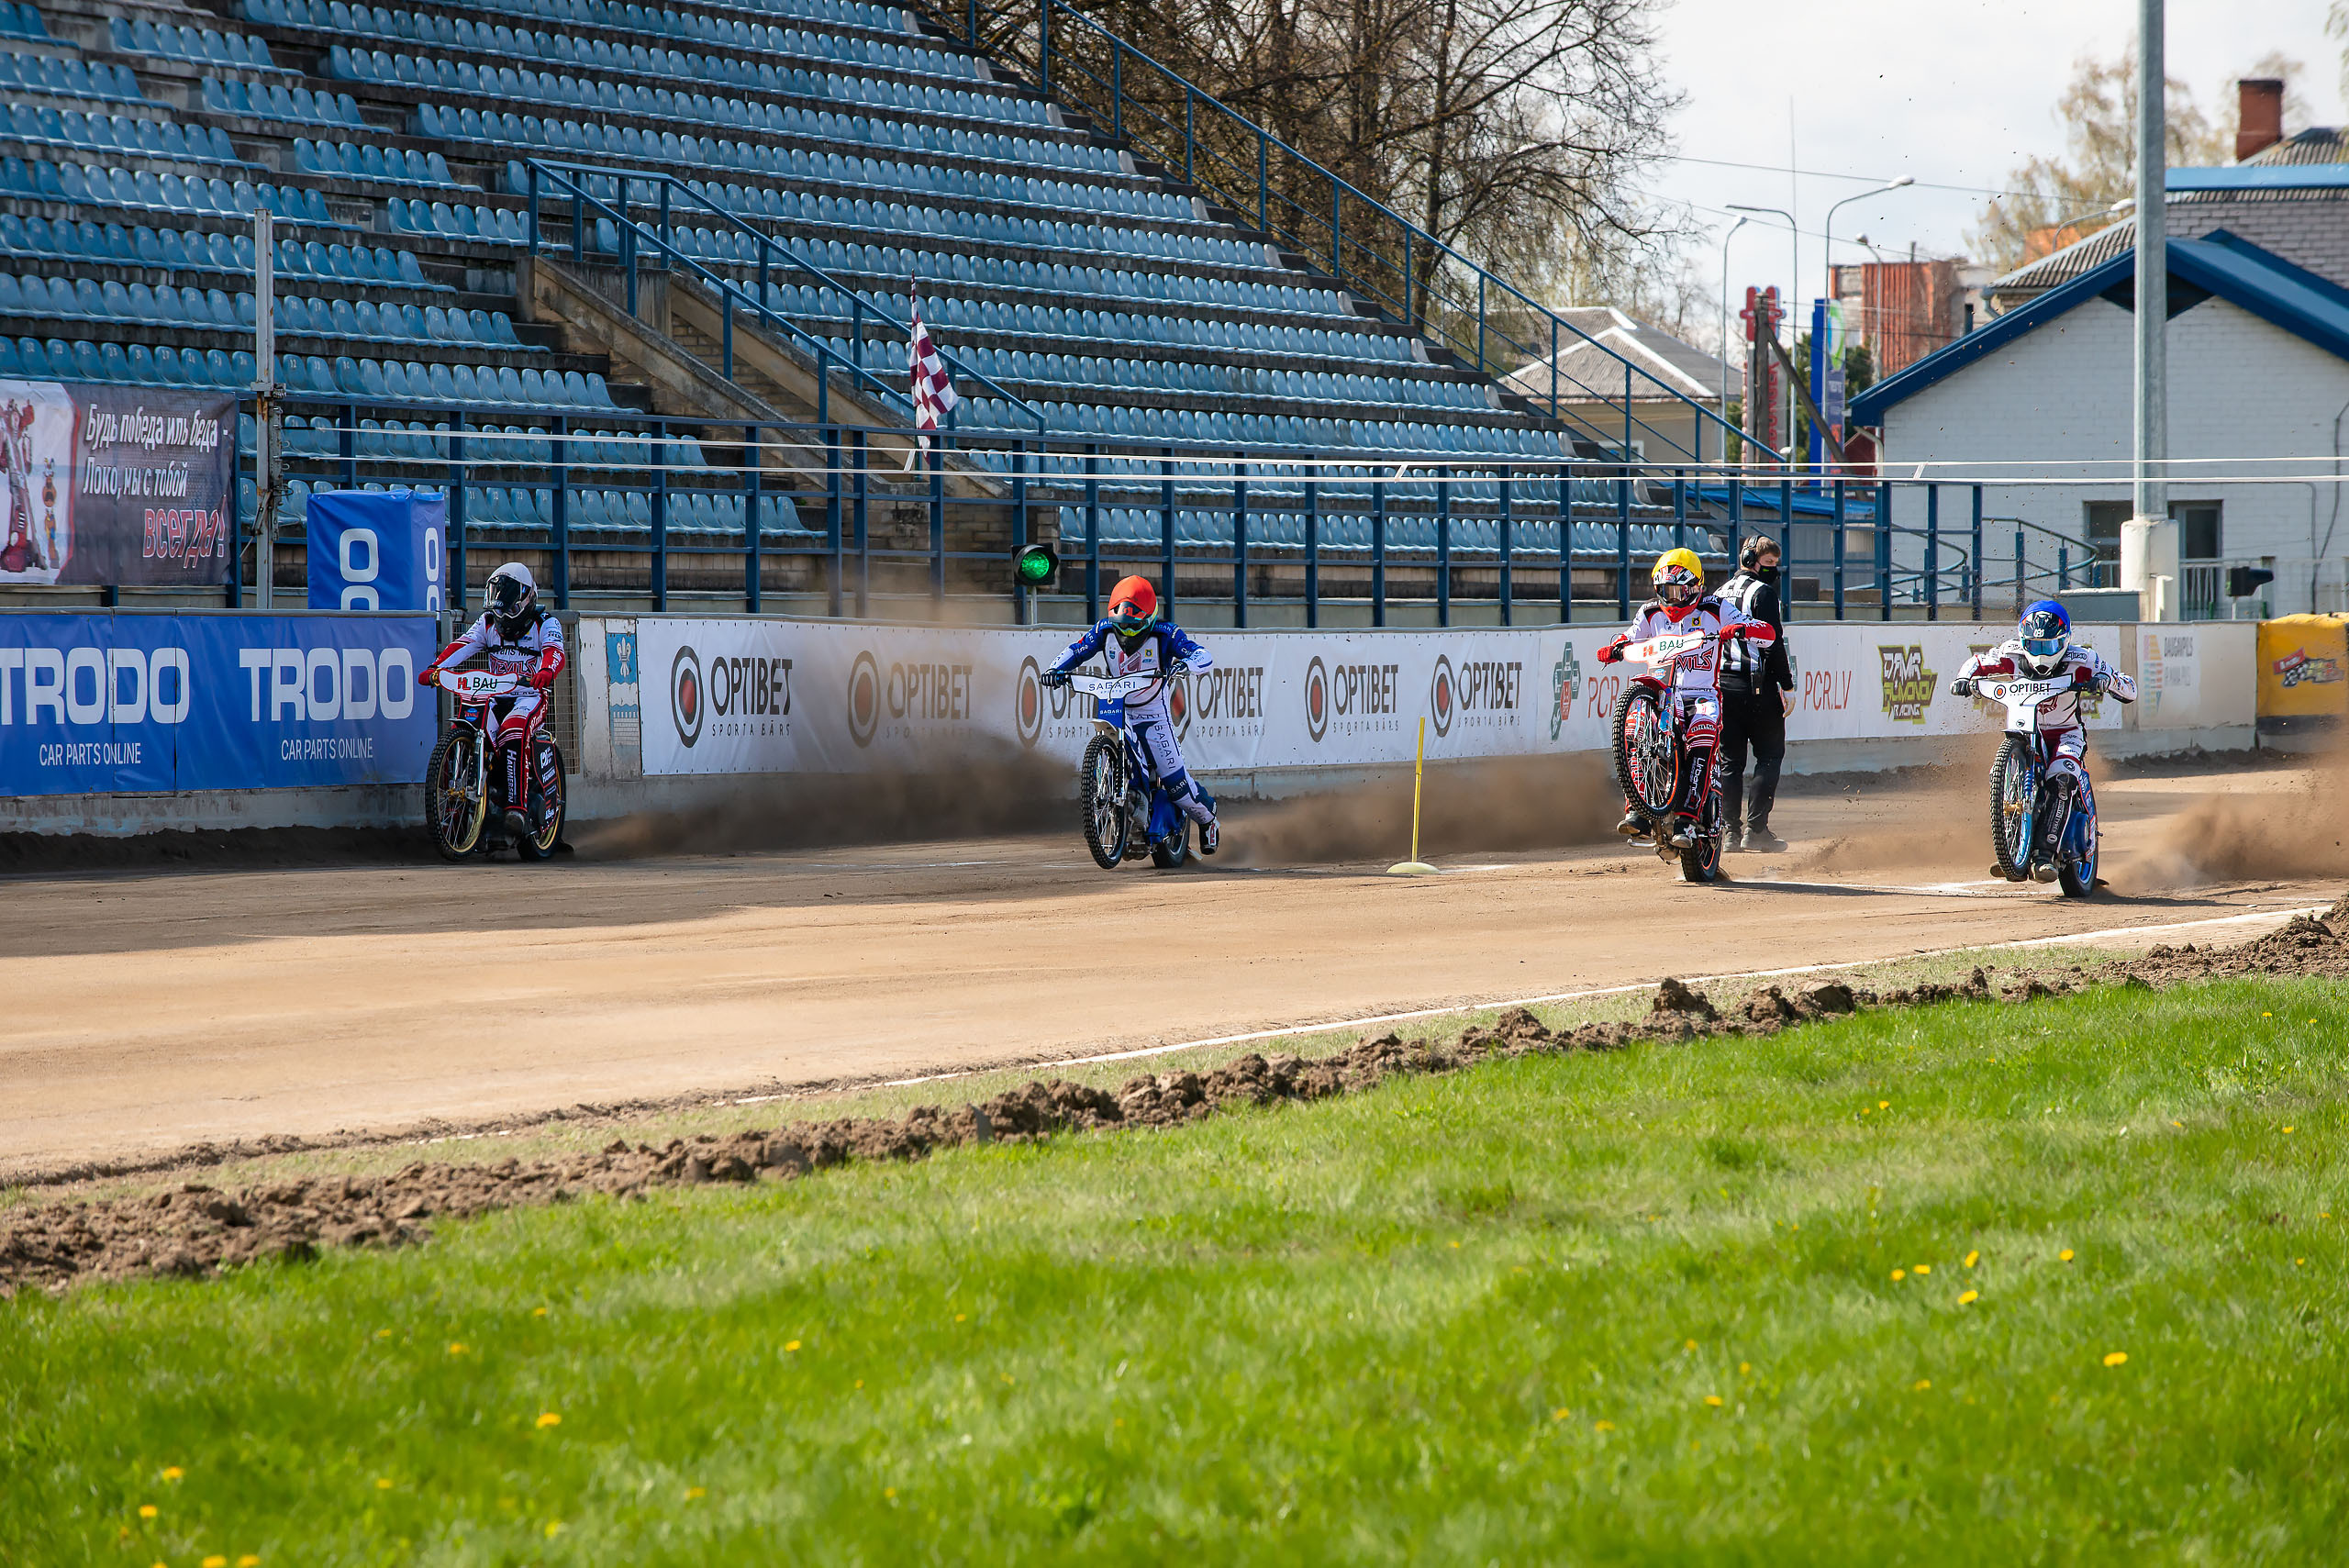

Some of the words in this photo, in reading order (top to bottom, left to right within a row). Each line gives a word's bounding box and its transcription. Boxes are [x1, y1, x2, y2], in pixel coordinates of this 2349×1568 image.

[85, 404, 119, 450] Будь
[120, 406, 162, 450] победа
[166, 416, 187, 445] иль
[189, 409, 218, 452] беда
[83, 456, 121, 500] Локо,
[124, 466, 140, 496] мы
[143, 470, 151, 496] с
[154, 460, 188, 497] тобой
[142, 494, 227, 569] всегда!
[1659, 639, 1685, 651] BAU
[0, 647, 190, 726] TRODO
[239, 647, 414, 722] TRODO
[473, 677, 498, 689] BAU
[711, 656, 792, 716] OPTIBET
[887, 662, 973, 720] OPTIBET
[1089, 681, 1136, 692] SAGARI
[1197, 667, 1263, 719] OPTIBET
[1334, 664, 1398, 716] OPTIBET
[1458, 662, 1522, 710] OPTIBET
[1804, 671, 1852, 711] PCR.LV
[2009, 683, 2052, 694] OPTIBET
[712, 723, 754, 736] SPORTA
[1049, 727, 1089, 738] SPORTA
[1197, 726, 1236, 738] SPORTA
[1333, 721, 1370, 733] SPORTA
[39, 744, 63, 767] CAR
[66, 743, 101, 766] PARTS
[103, 742, 141, 765] ONLINE
[281, 740, 302, 761] CAR
[304, 739, 336, 760] PARTS
[338, 738, 373, 759] ONLINE
